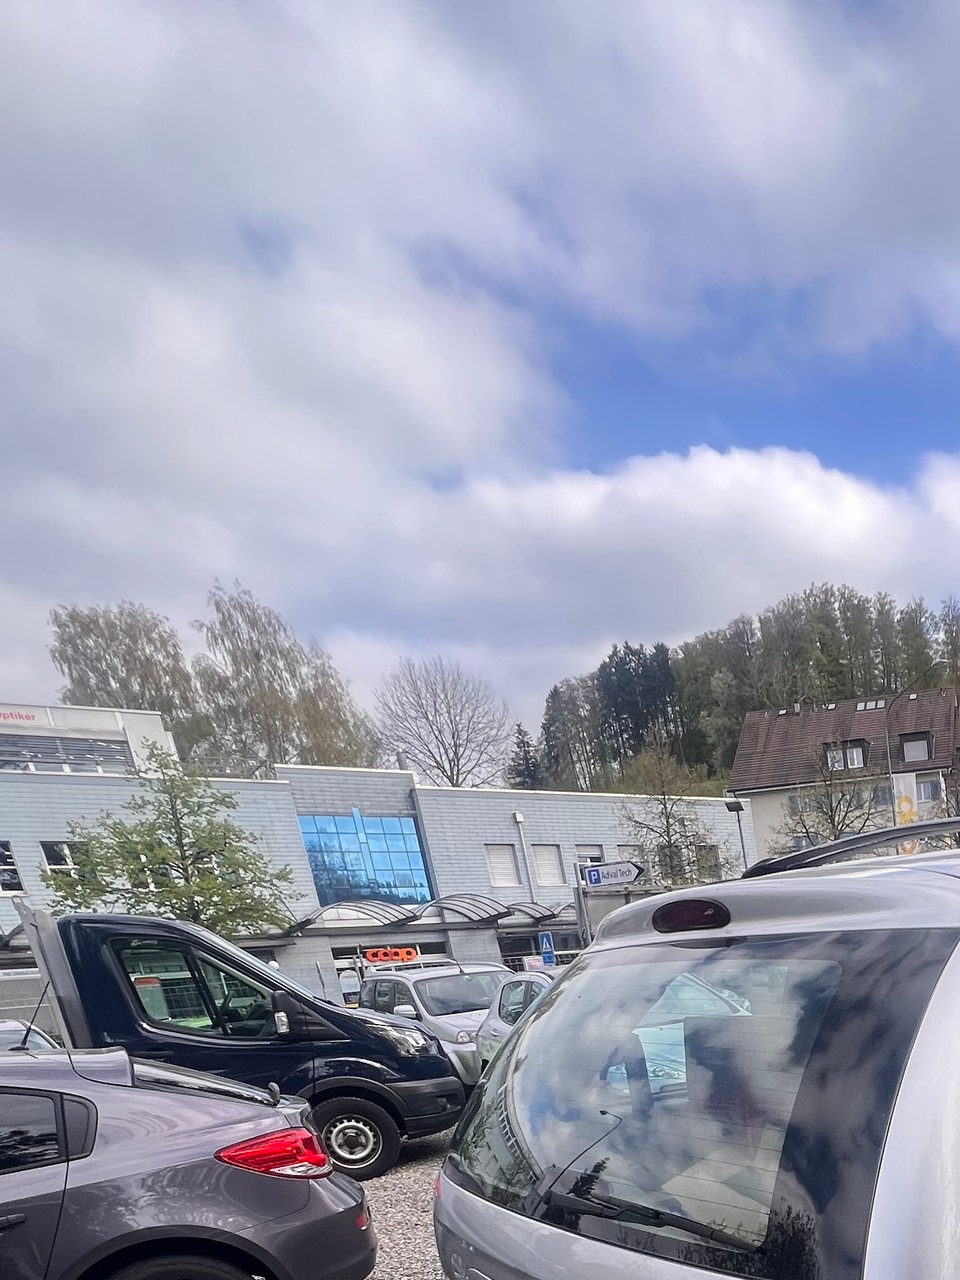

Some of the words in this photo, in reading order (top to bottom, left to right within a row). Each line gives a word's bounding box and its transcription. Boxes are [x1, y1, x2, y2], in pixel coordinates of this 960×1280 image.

[0, 711, 36, 721] ptiker
[601, 869, 618, 880] Adval
[618, 867, 633, 877] Tech
[366, 947, 417, 962] coop
